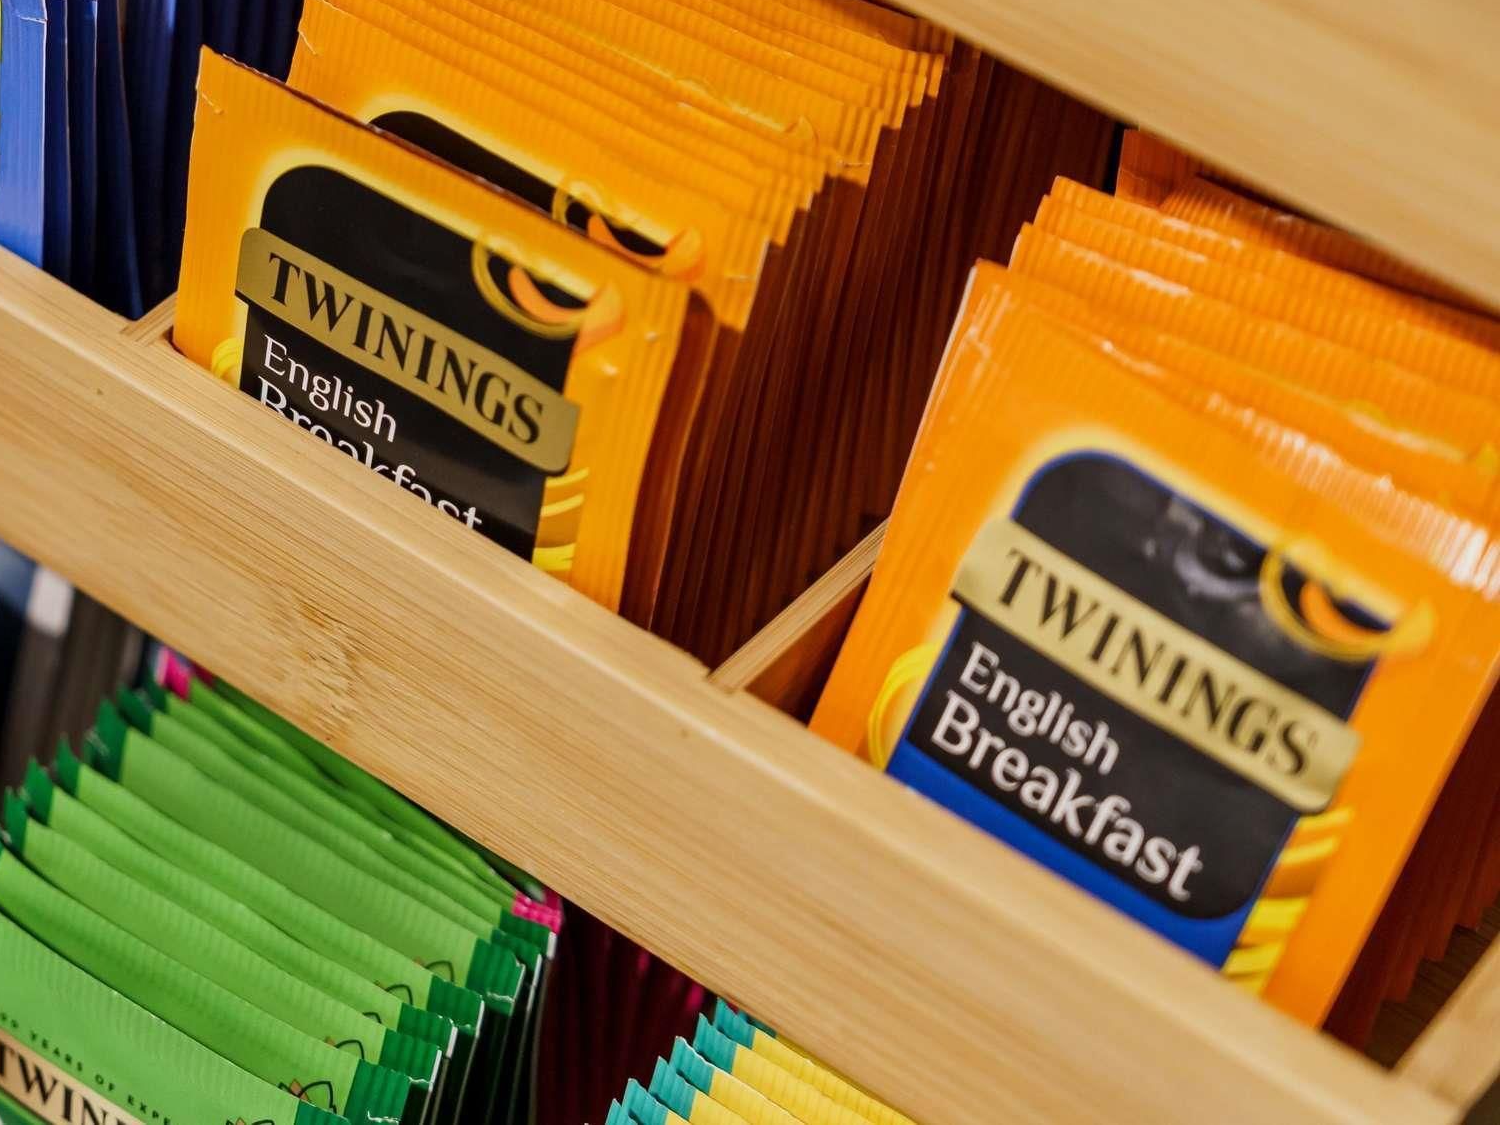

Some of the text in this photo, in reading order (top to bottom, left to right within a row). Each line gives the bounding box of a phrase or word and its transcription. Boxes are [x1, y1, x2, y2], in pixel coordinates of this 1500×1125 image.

[263, 333, 397, 443] English
[268, 251, 545, 446] TWININGS
[958, 641, 1121, 776] English
[999, 547, 1314, 777] TWININGS
[930, 689, 1203, 902] Breakfast
[30, 1029, 83, 1073] YEARS
